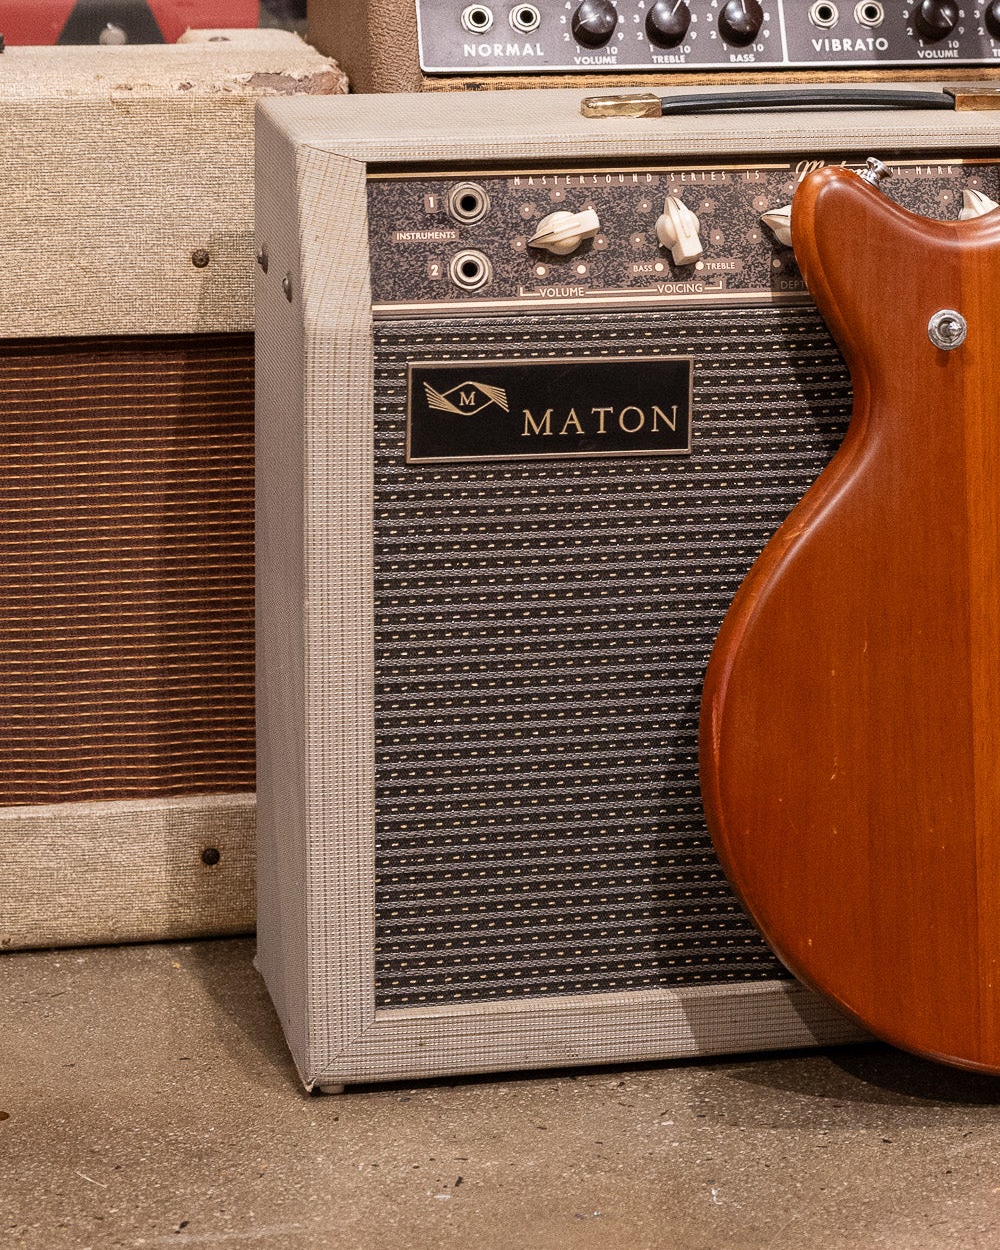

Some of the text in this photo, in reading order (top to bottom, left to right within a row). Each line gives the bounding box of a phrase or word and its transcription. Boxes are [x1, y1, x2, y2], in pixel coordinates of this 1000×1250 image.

[565, 1, 571, 10] 4
[638, 0, 645, 9] 4
[711, 0, 718, 8] 4
[633, 14, 640, 23] 3
[706, 13, 713, 22] 3
[903, 10, 909, 19] 3
[974, 10, 980, 19] 3
[560, 15, 566, 24] 3
[637, 32, 644, 40] 2
[710, 30, 717, 39] 2
[906, 27, 914, 36] 2
[977, 27, 985, 36] 2
[563, 33, 570, 41] 2
[723, 43, 728, 51] 1
[752, 43, 765, 52] 10
[812, 37, 889, 52] VIBRATO
[919, 39, 924, 48] 1
[948, 40, 960, 48] 10
[989, 39, 995, 47] 1
[463, 43, 545, 57] NORMAL
[576, 45, 580, 54] 1
[606, 46, 618, 55] 10
[649, 44, 654, 52] 1
[680, 45, 691, 53] 10
[729, 54, 756, 63] BASS
[917, 49, 959, 59] VOLUME
[574, 56, 618, 65] VOLUME
[652, 55, 686, 64] TREBLE
[513, 173, 653, 185] MASTERSOUND
[670, 171, 726, 182] SERIES
[428, 196, 434, 208] 1
[396, 231, 456, 241] INSTRUMENTS
[430, 264, 439, 276] 2
[633, 264, 653, 273] BASS
[706, 262, 736, 270] TREBLE
[539, 287, 585, 298] VOLUME
[657, 283, 704, 294] VOICING
[459, 391, 476, 406] M
[521, 405, 678, 436] MATON
